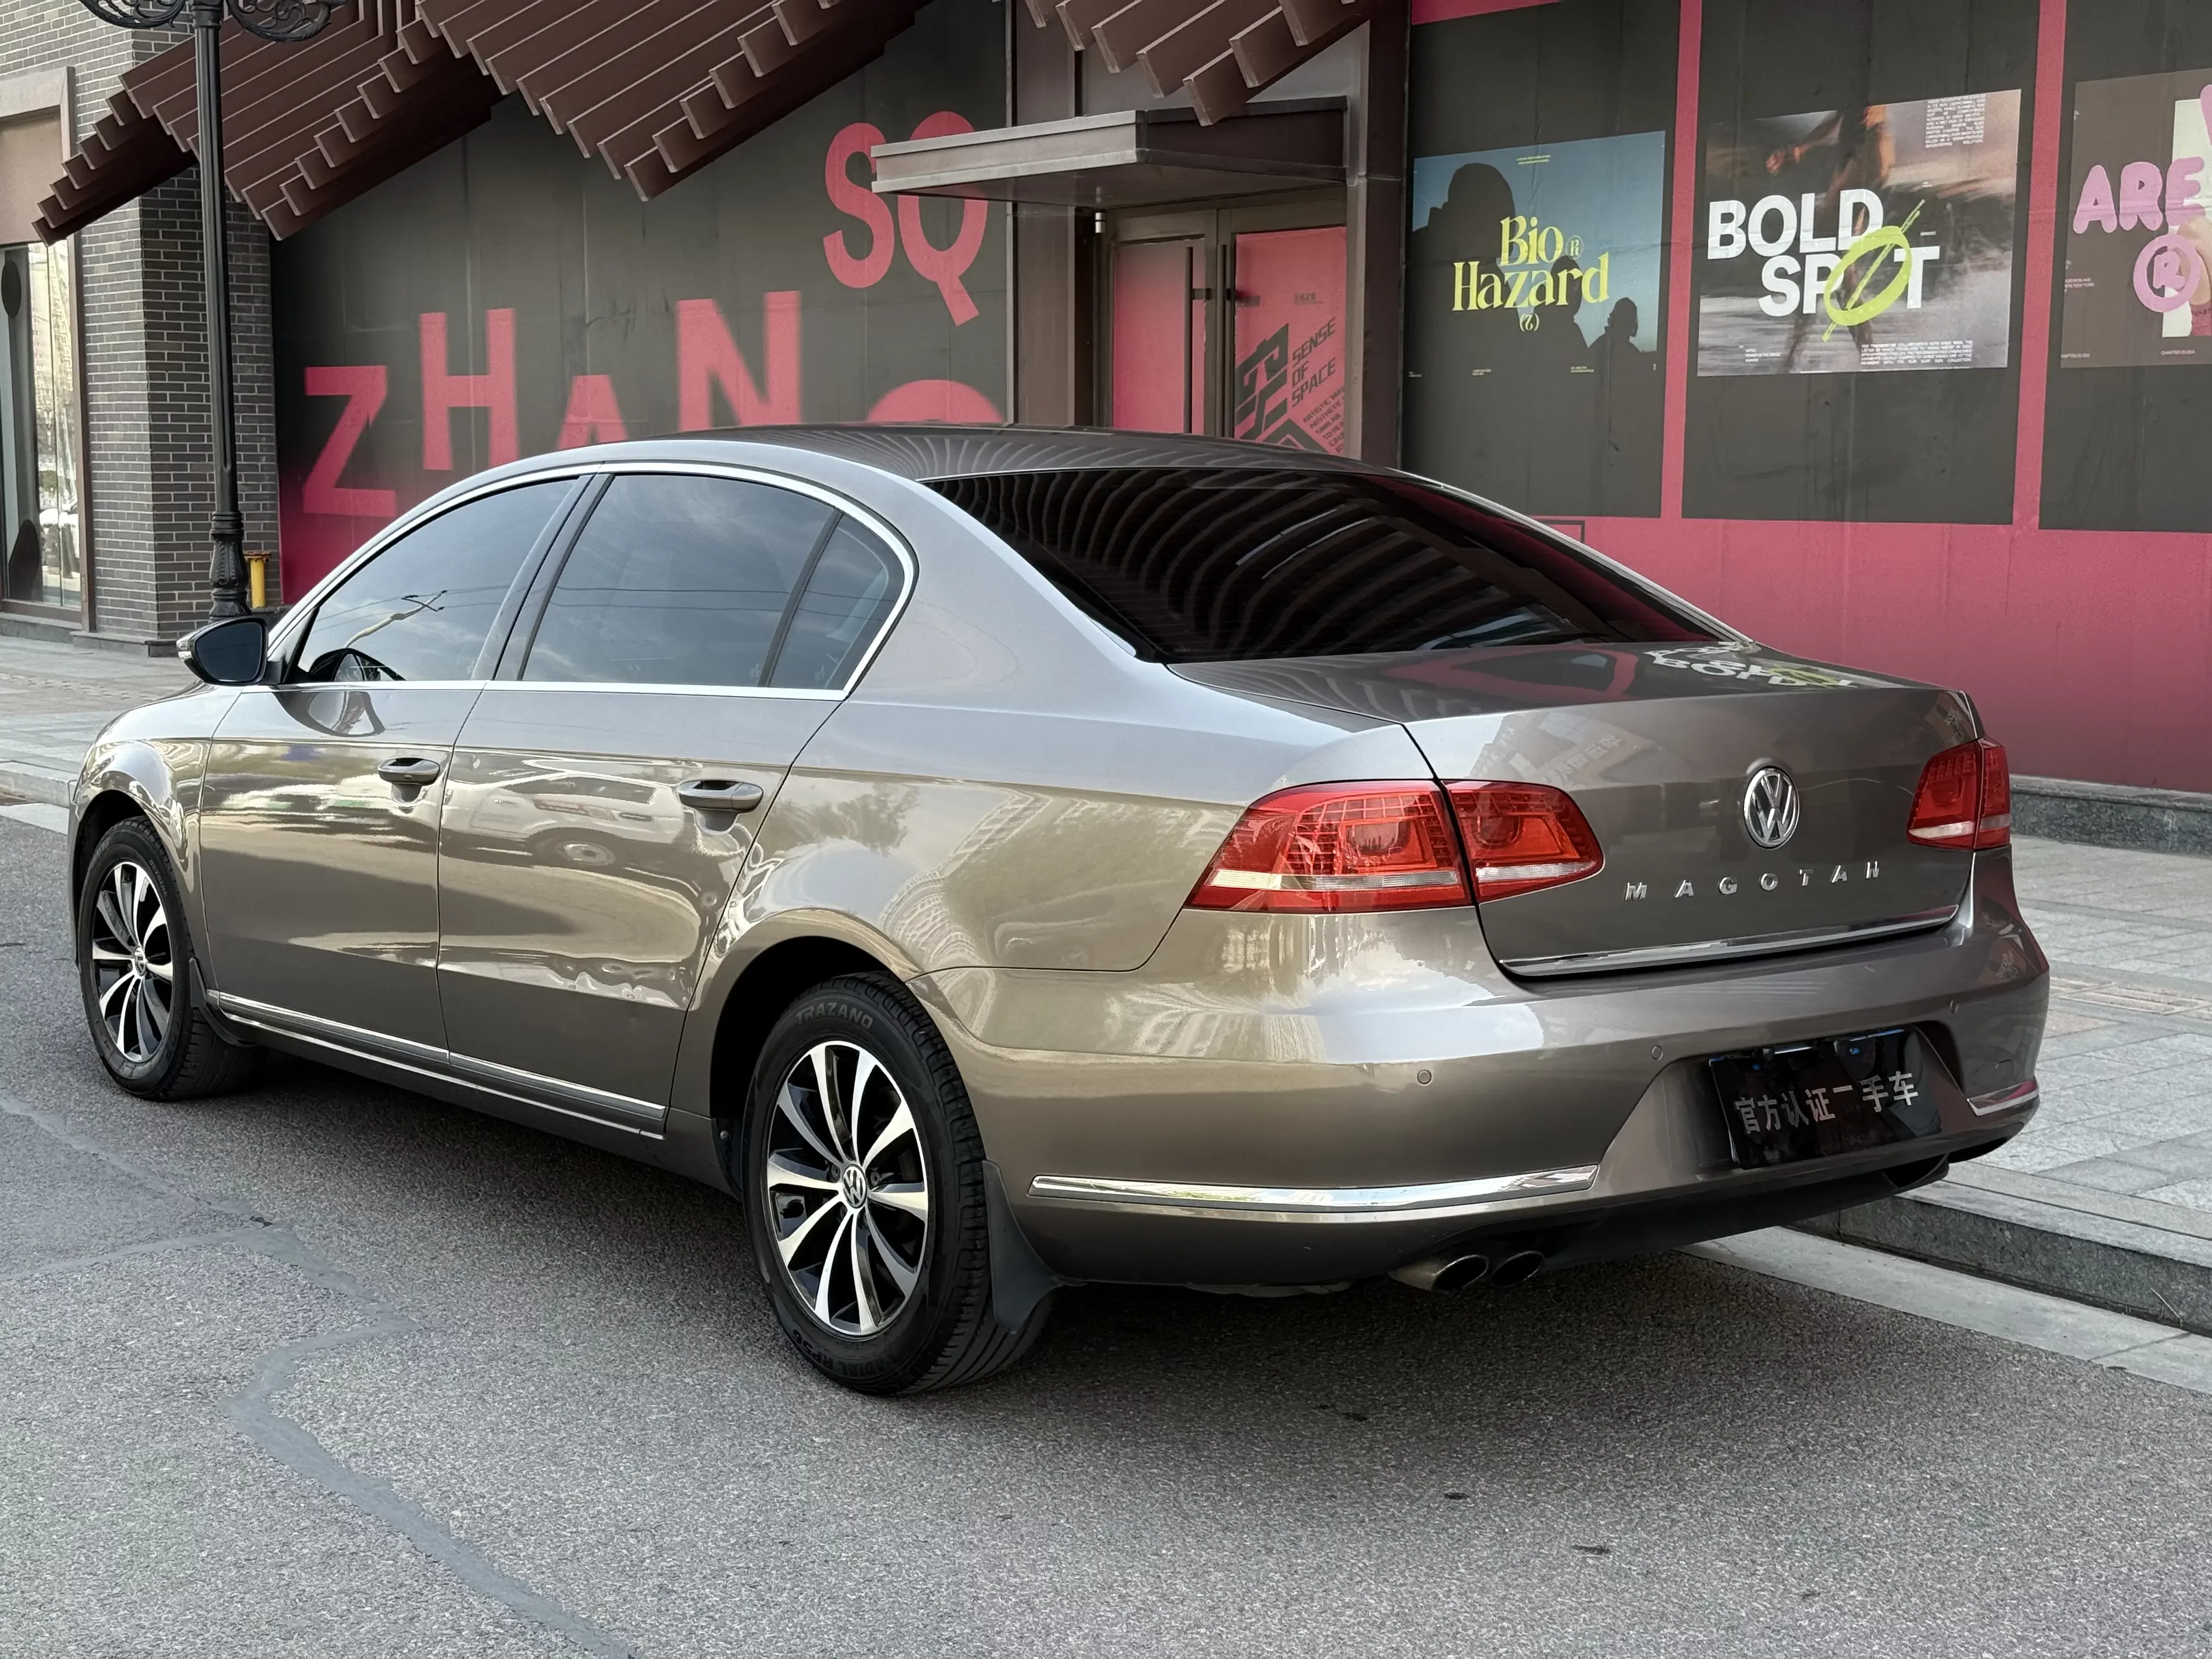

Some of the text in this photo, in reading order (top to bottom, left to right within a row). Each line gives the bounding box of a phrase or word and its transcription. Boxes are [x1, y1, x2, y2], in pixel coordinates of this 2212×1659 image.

[2072, 156, 2205, 234] ARE
[1499, 215, 1564, 267] Bio
[1707, 188, 1884, 261] BOLD
[1451, 251, 1611, 312] Hazard
[1292, 317, 1336, 368] SENSE
[1291, 357, 1336, 408] SPACE
[1292, 360, 1309, 388] OF
[1623, 859, 1880, 901] MAGOTAN
[795, 1002, 874, 1030] TRAZANO
